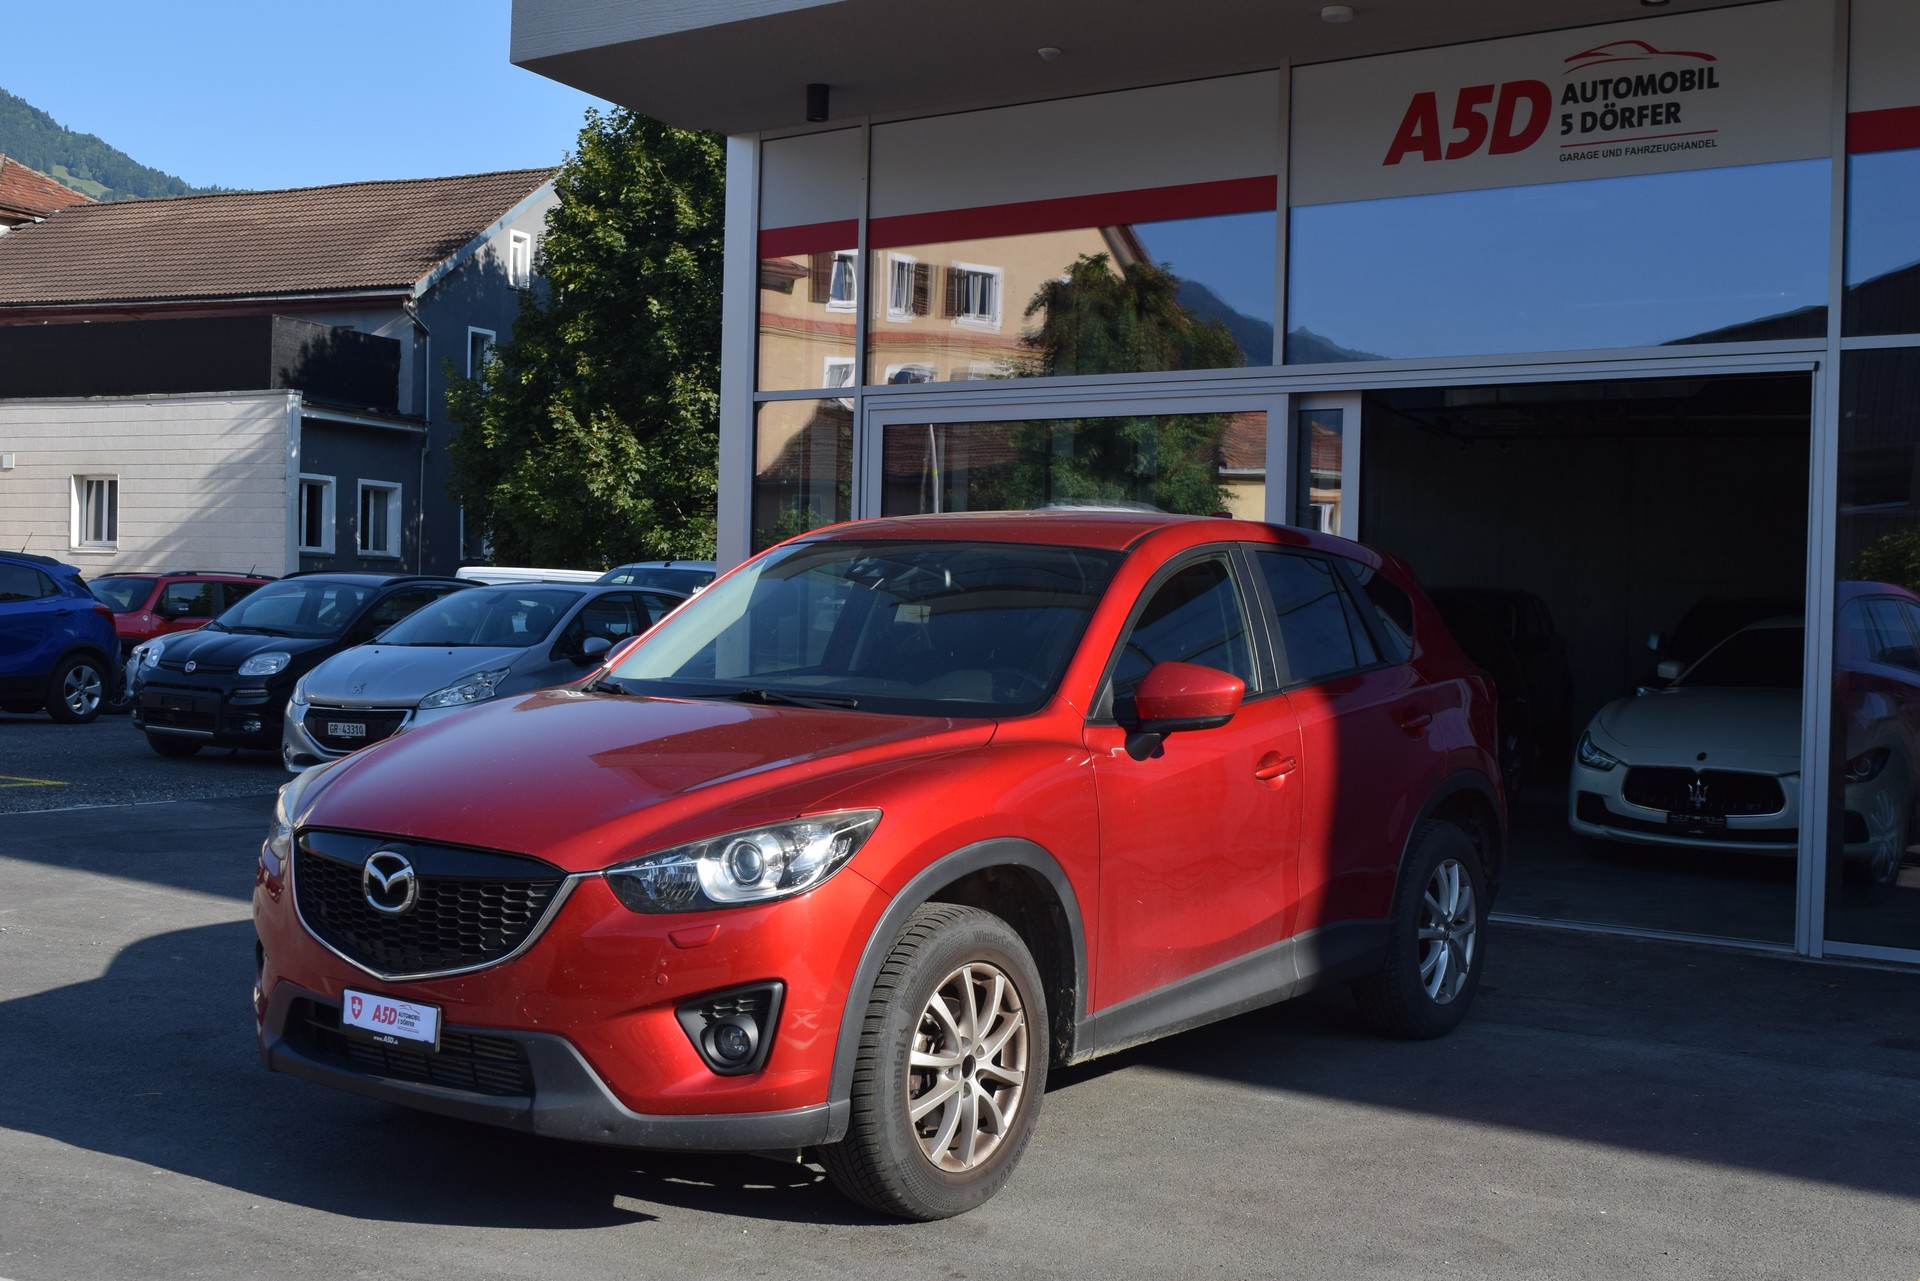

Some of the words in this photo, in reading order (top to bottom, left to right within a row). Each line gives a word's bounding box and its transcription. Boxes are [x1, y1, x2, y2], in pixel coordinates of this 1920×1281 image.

[1560, 66, 1719, 106] AUTOMOBIL
[1382, 79, 1553, 166] A5D
[1560, 113, 1573, 136] 5
[1580, 102, 1682, 134] DÖRFER
[1559, 150, 1600, 162] GARAGE
[1602, 148, 1623, 158] UND
[1624, 139, 1718, 156] FAHRZEUGHANDEL
[372, 1004, 397, 1025] A5D
[398, 1011, 420, 1021] AUTOMOBIL
